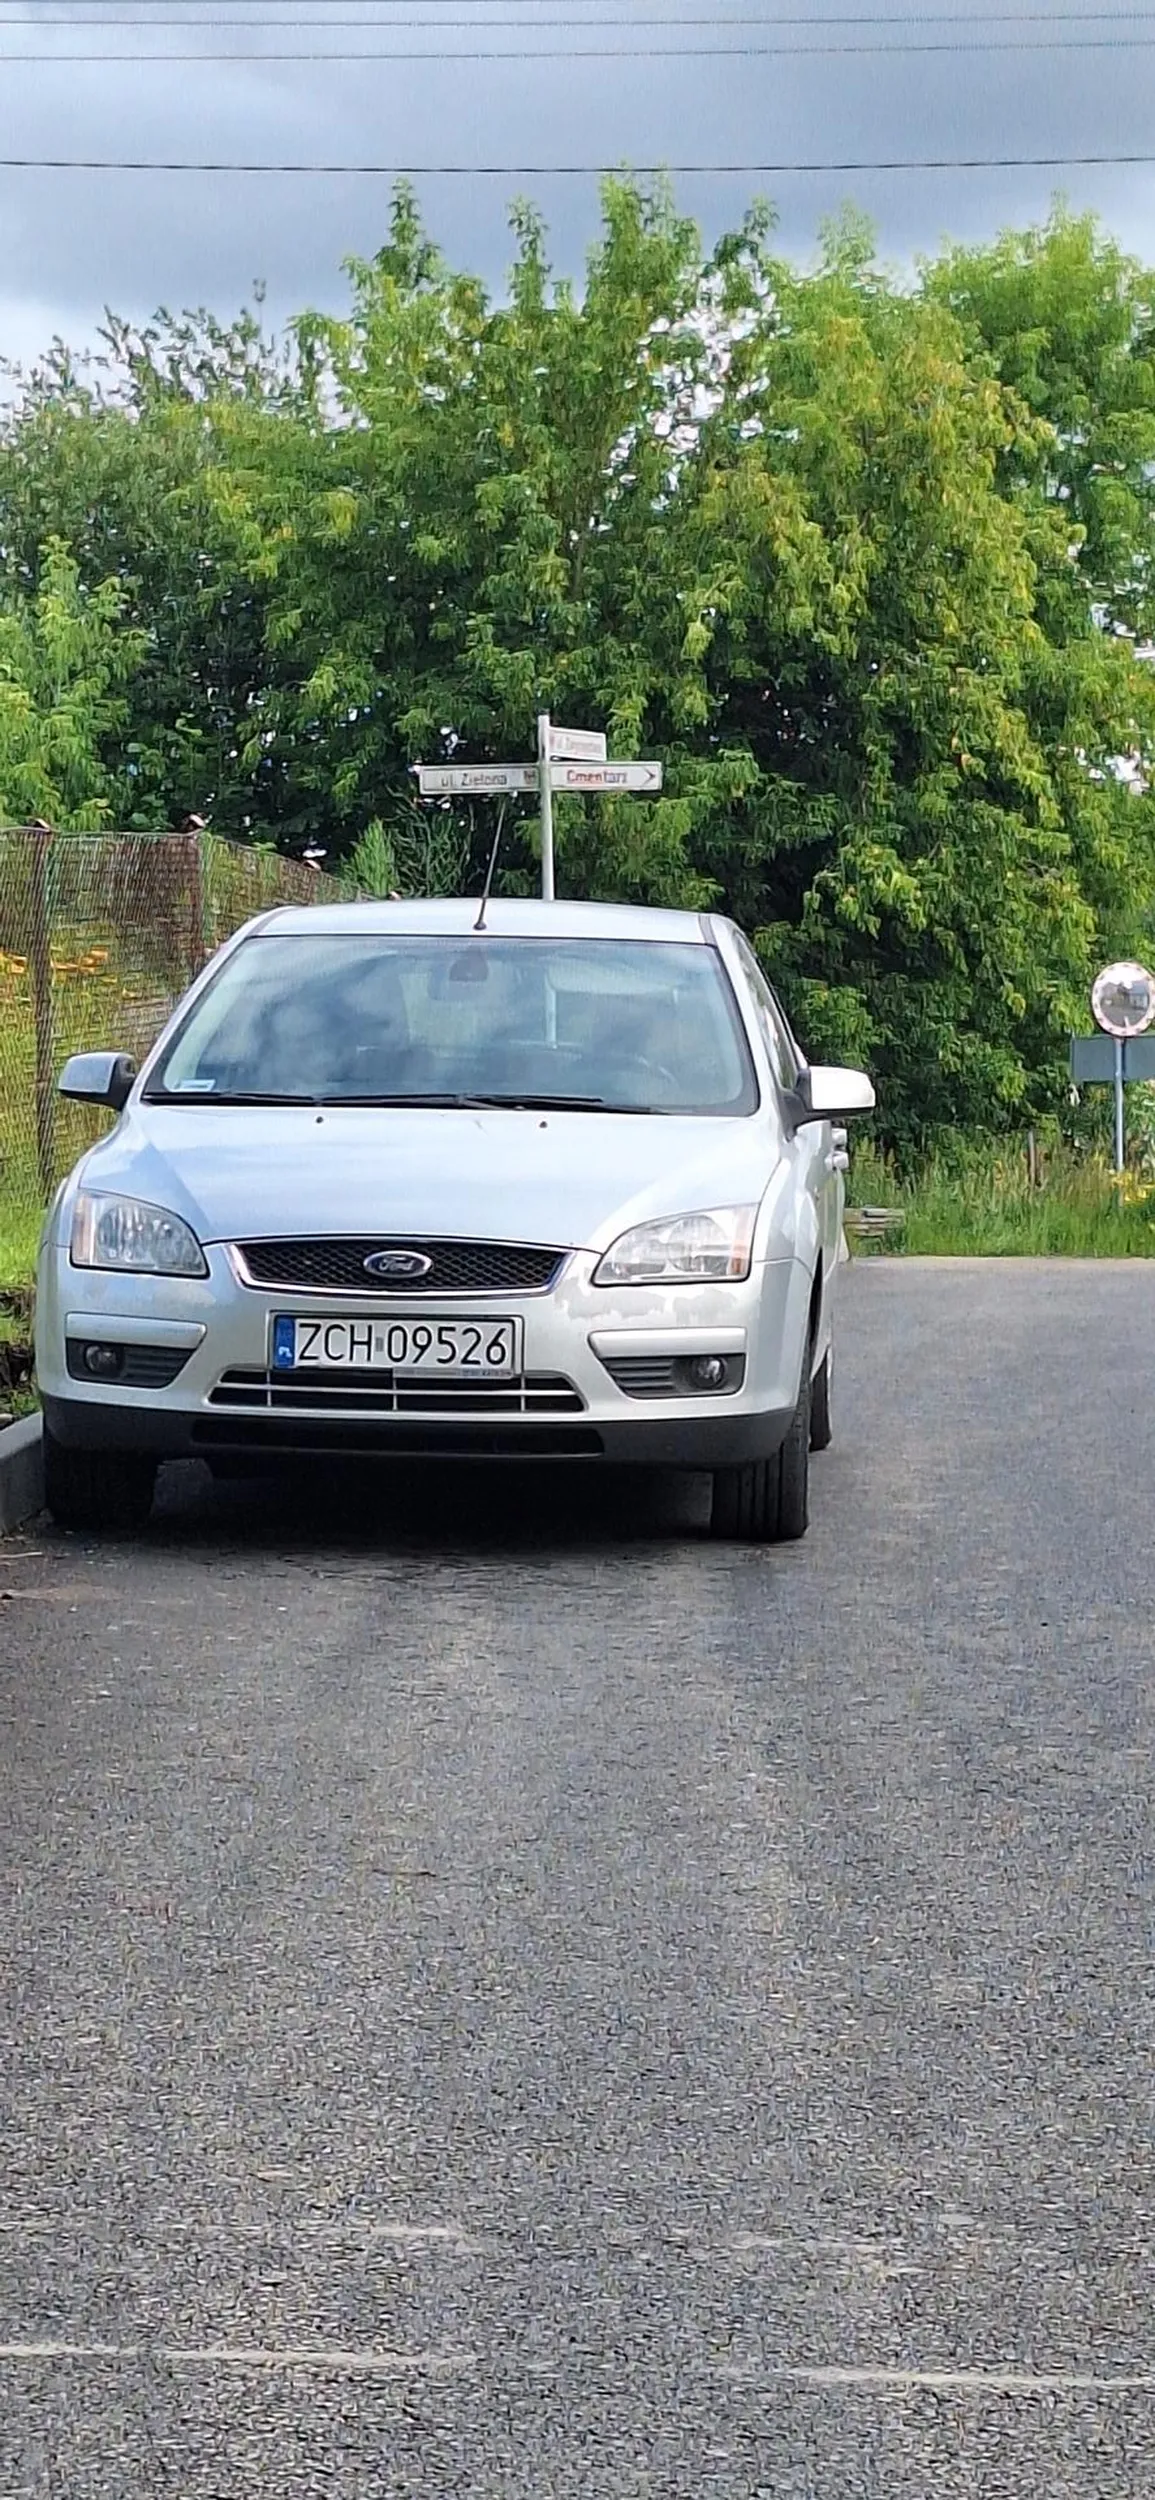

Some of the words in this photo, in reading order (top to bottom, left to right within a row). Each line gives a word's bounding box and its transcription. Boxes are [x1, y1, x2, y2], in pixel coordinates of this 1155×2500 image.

[378, 1255, 416, 1272] Ford
[299, 1323, 373, 1362] ZCH
[387, 1325, 508, 1366] 09526
